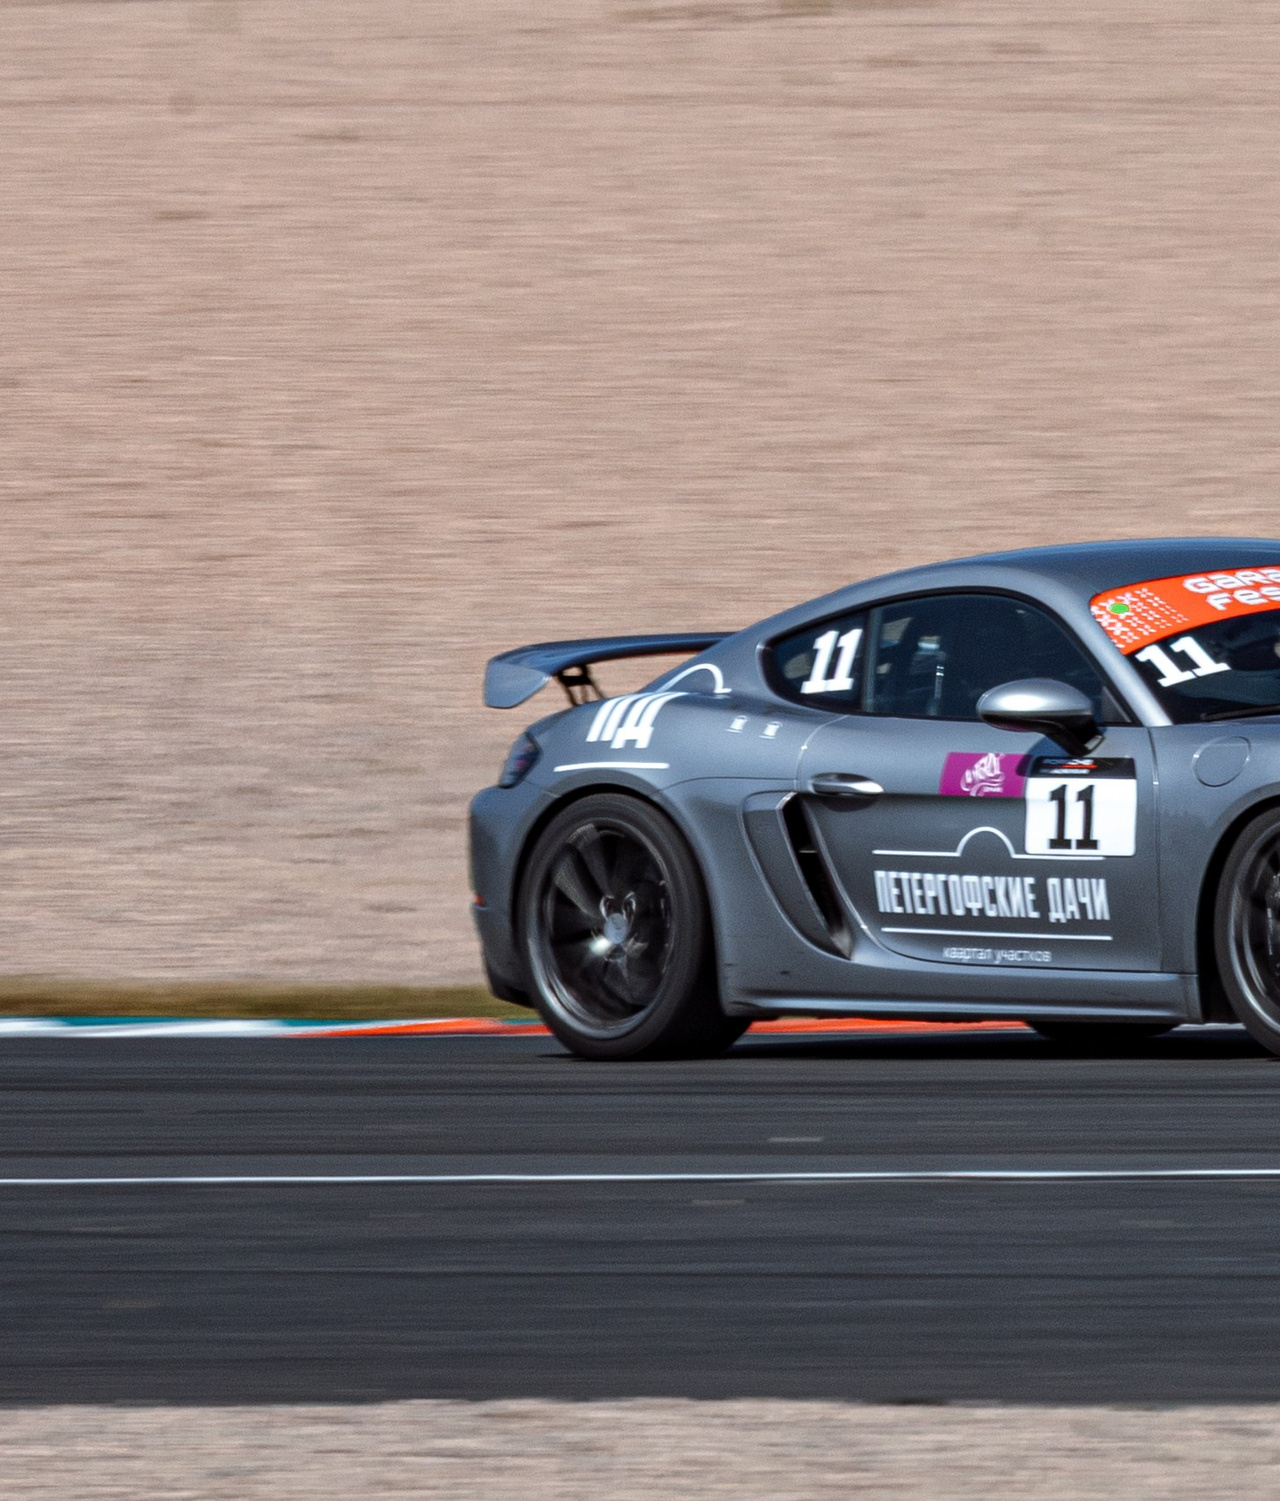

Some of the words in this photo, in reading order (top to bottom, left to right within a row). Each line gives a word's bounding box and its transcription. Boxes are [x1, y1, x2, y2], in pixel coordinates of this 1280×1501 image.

[800, 628, 864, 695] 11
[1134, 635, 1232, 688] 11
[1048, 784, 1100, 850] 11
[874, 870, 1041, 919] ПЕТЕРГОФСКИЕ
[1047, 877, 1111, 923] ДАЧИ
